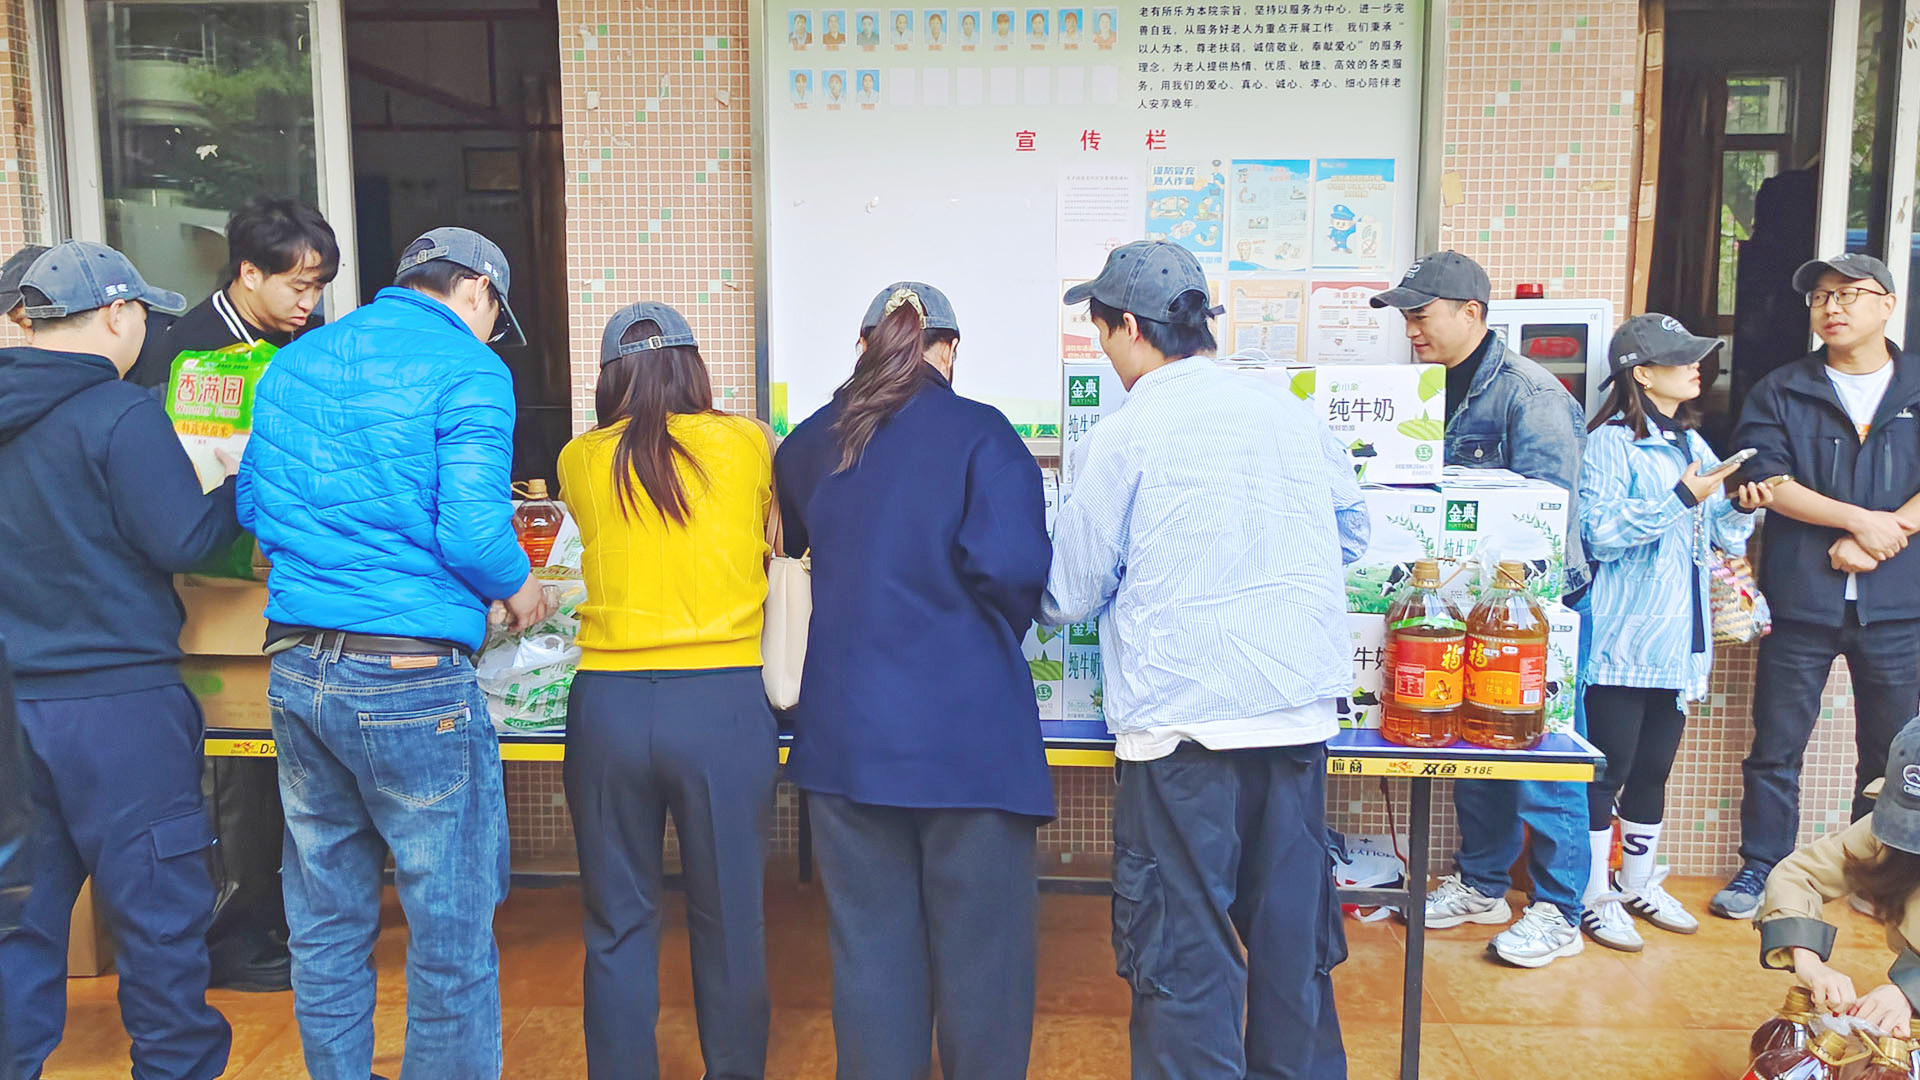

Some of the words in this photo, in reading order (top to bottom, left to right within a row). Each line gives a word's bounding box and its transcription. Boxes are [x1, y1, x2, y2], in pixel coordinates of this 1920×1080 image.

[1016, 130, 1167, 151] 宣传栏
[177, 374, 243, 406] 香满园
[1070, 379, 1098, 398] 金典
[1329, 397, 1394, 422] 纯牛奶
[1448, 503, 1477, 523] 金典
[1441, 643, 1461, 670] 福
[1469, 640, 1488, 668] 福
[1420, 763, 1457, 776] 双鱼
[1463, 766, 1494, 775] 518E
[1622, 833, 1655, 855] S
